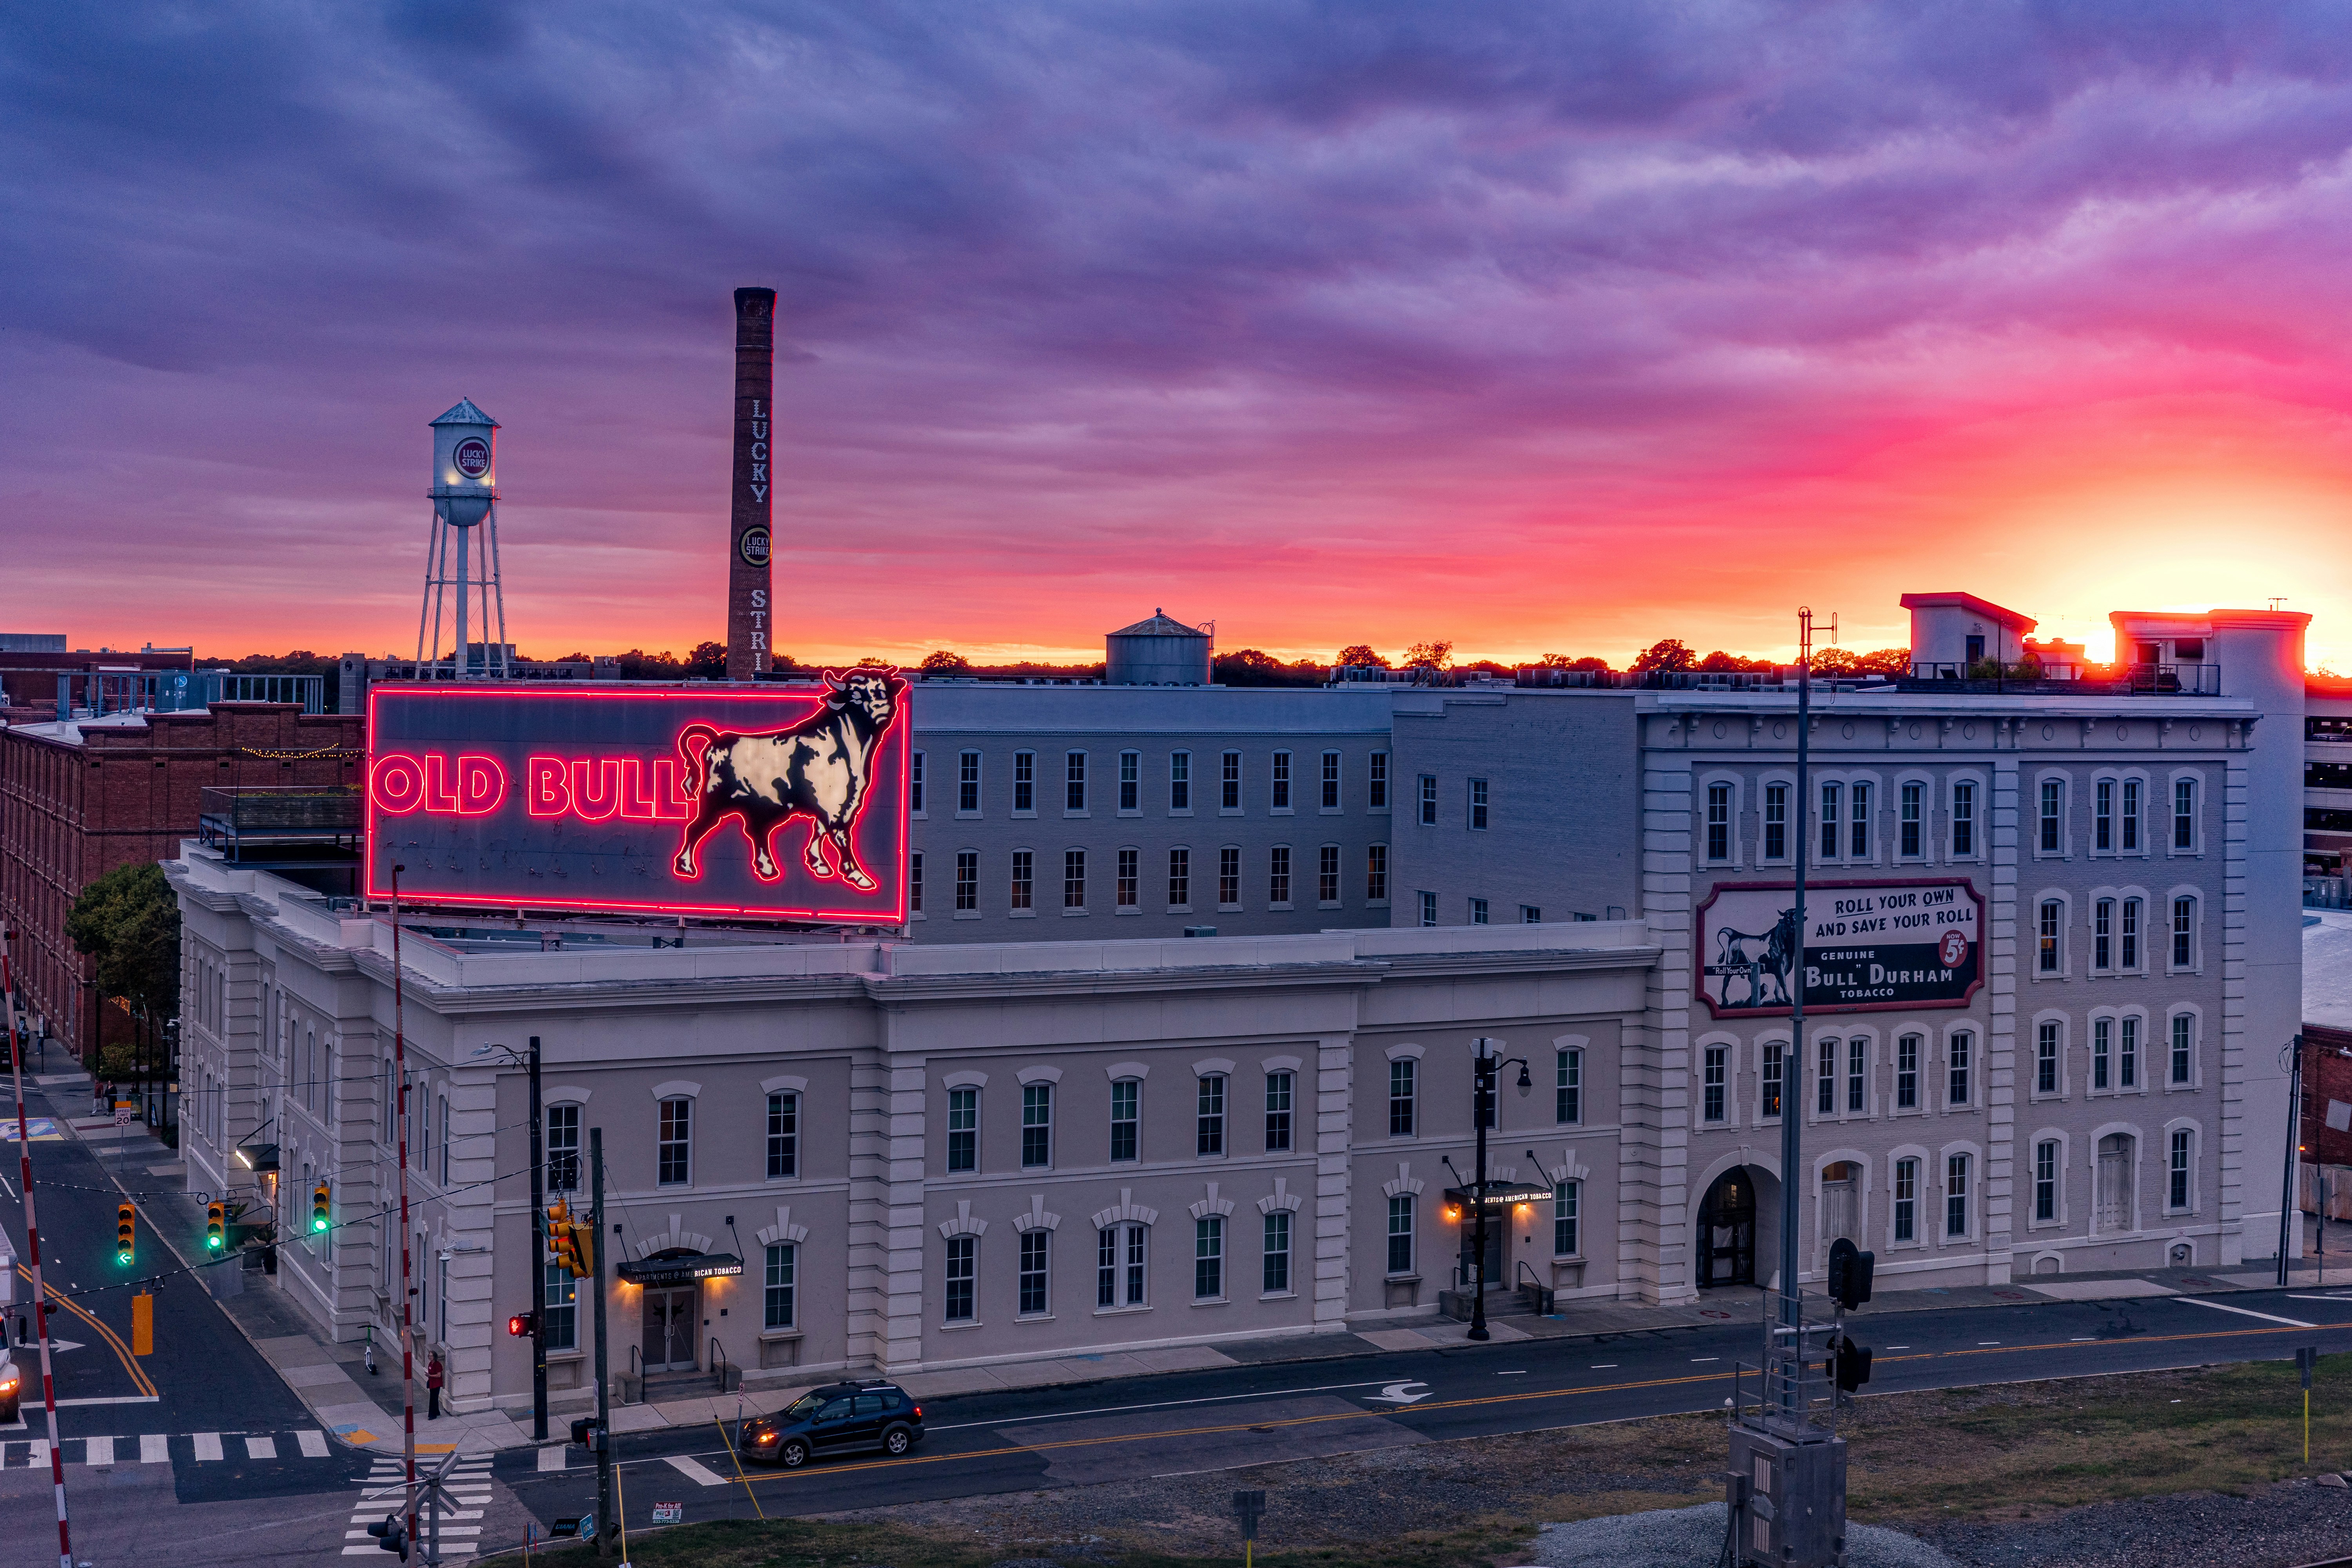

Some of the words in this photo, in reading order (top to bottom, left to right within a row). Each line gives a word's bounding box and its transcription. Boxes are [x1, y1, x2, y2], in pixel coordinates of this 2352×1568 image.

[463, 450, 485, 458] LUCKY
[750, 400, 767, 502] LUCKY
[462, 458, 485, 467] STRIKE
[747, 537, 769, 546] LUCKY
[746, 546, 769, 555] STRIKE
[750, 590, 766, 681] STRI
[371, 755, 504, 813] OLD
[530, 758, 688, 819] BULL
[1835, 898, 1873, 915] ROLL
[1879, 893, 1916, 909] YOUR
[1923, 889, 1954, 905] OWN
[1816, 922, 1846, 938] AND
[1852, 917, 1887, 934] SAVE
[1893, 913, 1930, 929] YOUR
[1936, 908, 1973, 924] ROLL
[1821, 951, 1875, 960] GENUINE
[1869, 964, 1953, 984] DURHAM
[1840, 988, 1894, 998] TOBACCO
[1505, 1193, 1528, 1202] AMERICAN
[635, 1273, 671, 1281] APARTMENTS
[681, 1269, 712, 1278] AMERICAN
[714, 1266, 741, 1275] TOBACCO
